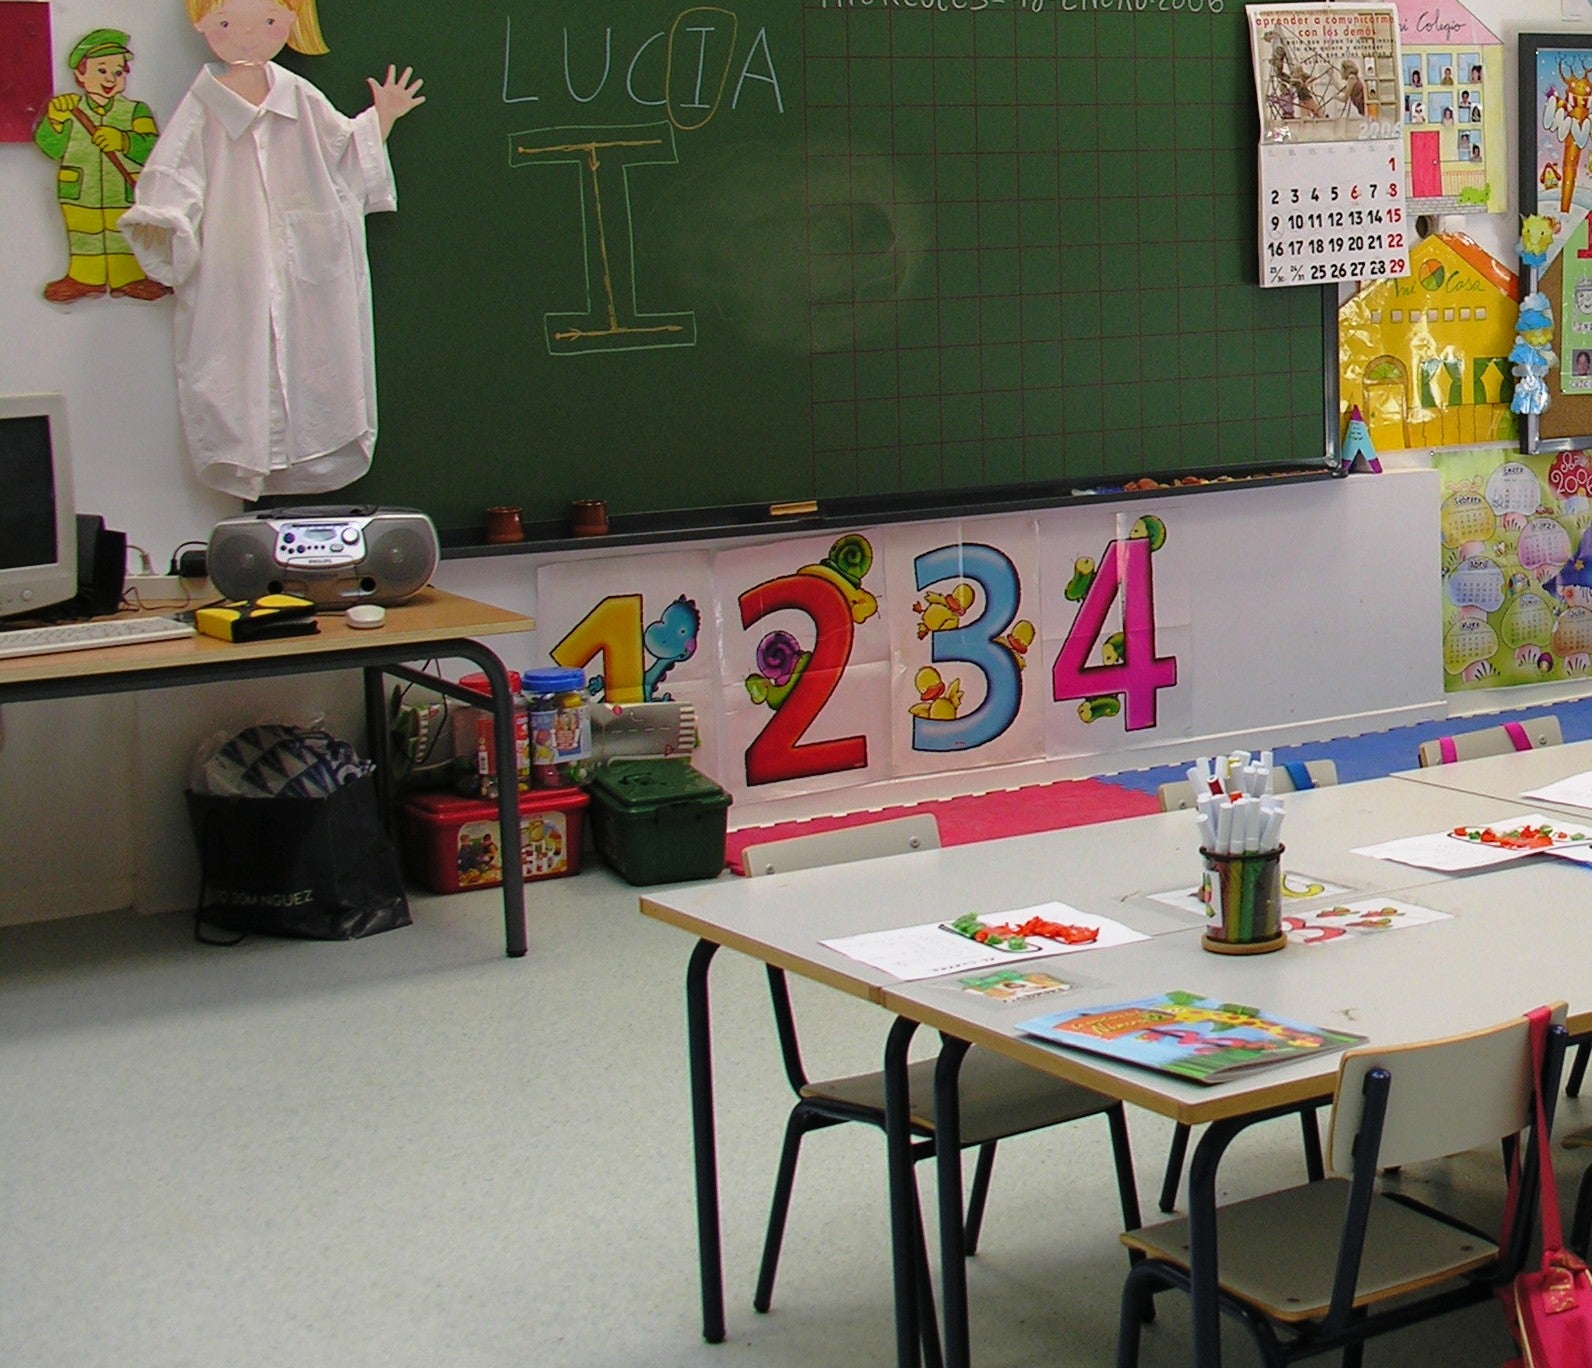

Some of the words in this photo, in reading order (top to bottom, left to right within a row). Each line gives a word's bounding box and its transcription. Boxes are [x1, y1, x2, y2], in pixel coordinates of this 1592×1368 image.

[1255, 15, 1308, 27] aprender
[1416, 9, 1467, 41] Colegio
[502, 16, 785, 114] LUCIA
[1389, 157, 1396, 171] 1
[1271, 190, 1280, 204] 2
[1291, 189, 1299, 203] 3
[1311, 188, 1319, 201] 4
[1331, 186, 1339, 200] 5
[1350, 185, 1360, 200] 6
[1369, 184, 1378, 198] 7
[1388, 183, 1398, 197] 8
[1271, 216, 1280, 231] 9
[1288, 214, 1304, 229] 10
[1308, 213, 1323, 228] 11
[1328, 212, 1343, 227] 12
[1349, 211, 1363, 225] 13
[1367, 209, 1383, 224] 14
[1386, 208, 1402, 223] 15
[1267, 242, 1284, 257] 16
[1288, 240, 1304, 255] 17
[1308, 239, 1324, 254] 18
[1328, 238, 1344, 253] 19
[1348, 236, 1364, 251] 20
[1367, 235, 1383, 250] 21
[1387, 233, 1404, 248] 22
[1310, 265, 1327, 280] 25
[1330, 263, 1347, 279] 26
[1350, 262, 1366, 277] 27
[1370, 260, 1386, 275] 28
[1389, 258, 1406, 274] 29
[1445, 271, 1485, 293] Casa
[1052, 536, 1177, 732] 4
[912, 541, 1023, 753] 3
[737, 572, 868, 787] 2
